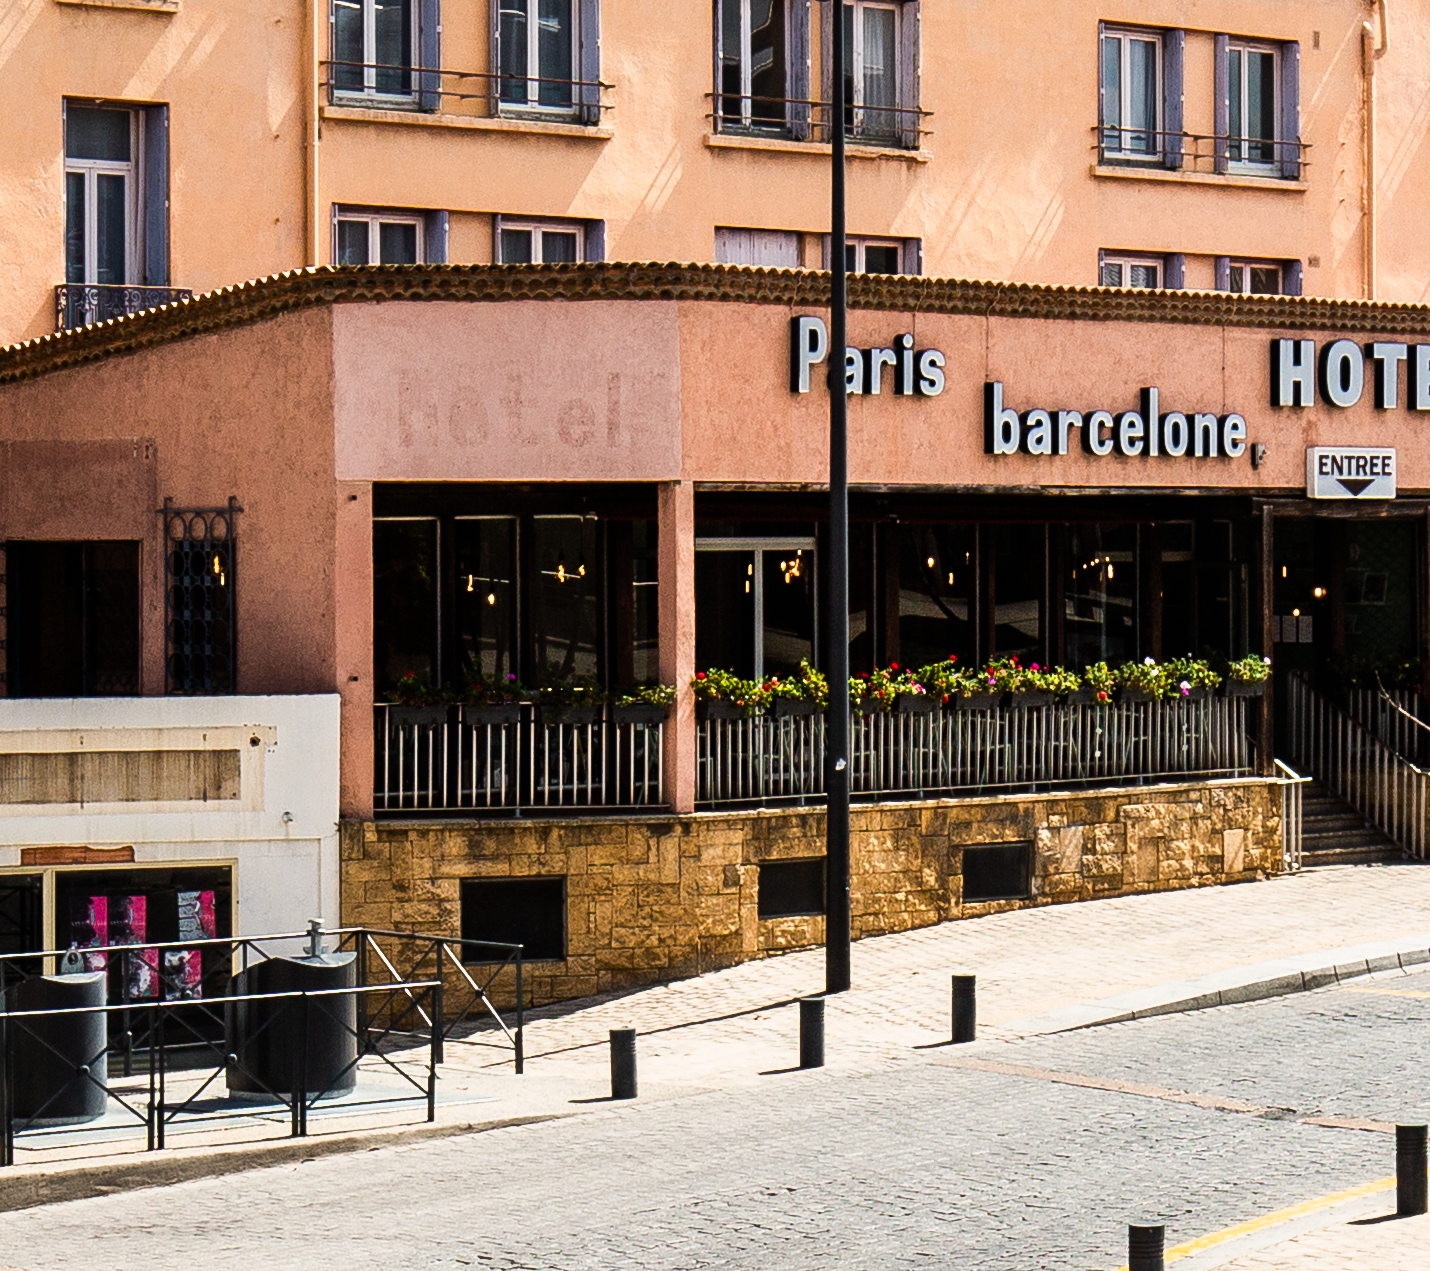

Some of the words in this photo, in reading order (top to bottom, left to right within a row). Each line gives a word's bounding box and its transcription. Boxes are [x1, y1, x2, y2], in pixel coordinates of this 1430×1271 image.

[790, 315, 946, 397] Paris
[984, 381, 1247, 457] barcelone
[1318, 454, 1393, 477] ENTREE
